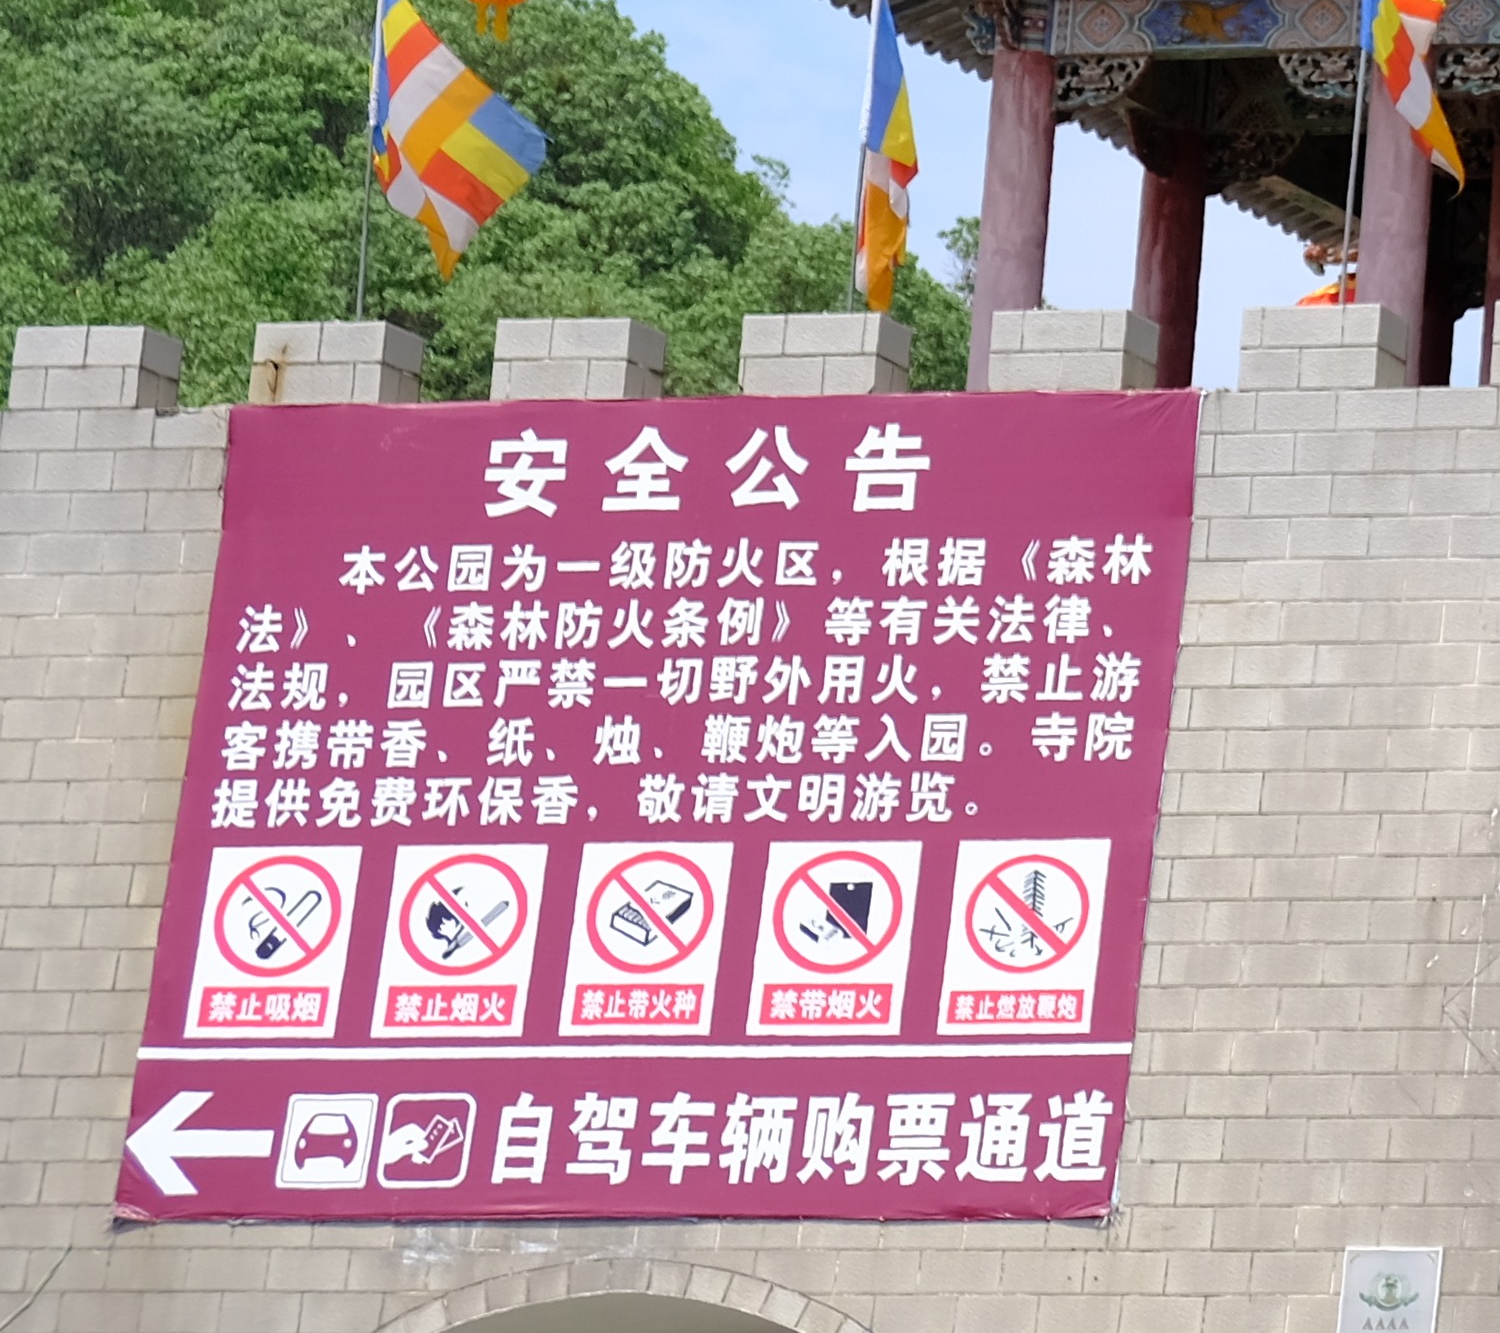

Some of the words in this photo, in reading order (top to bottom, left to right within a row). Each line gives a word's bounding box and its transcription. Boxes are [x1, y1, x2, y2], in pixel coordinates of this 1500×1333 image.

[484, 423, 931, 518] 安全公告
[208, 992, 321, 1023] 禁止吸烟
[394, 992, 506, 1023] 禁止烟火
[580, 988, 697, 1020] 禁止带火种
[769, 989, 882, 1020] 禁带烟火
[953, 991, 1078, 1022] 禁止燃放鞭炮
[490, 1089, 1114, 1189] 自驾车辆购票通道
